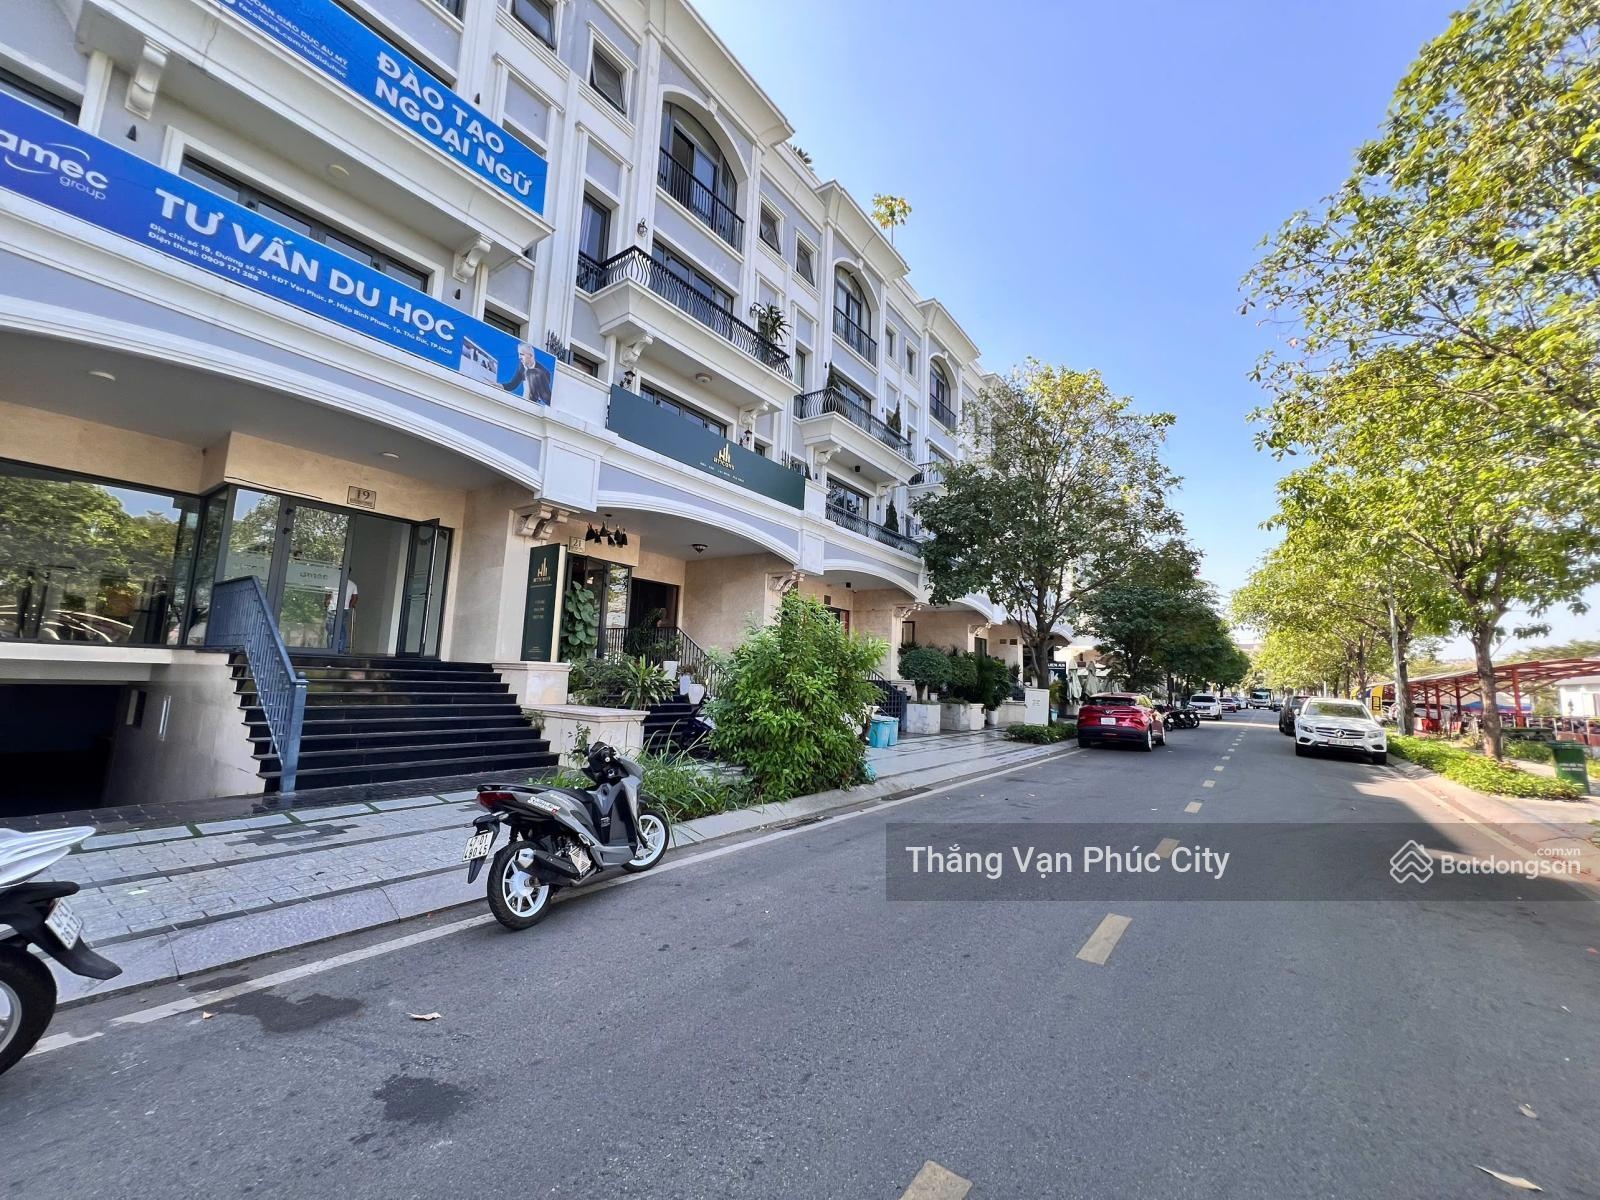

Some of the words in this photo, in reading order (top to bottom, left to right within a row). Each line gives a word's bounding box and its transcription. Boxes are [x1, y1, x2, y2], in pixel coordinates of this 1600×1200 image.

[376, 50, 444, 111] ĐÀO
[452, 103, 504, 153] TẠO
[0, 129, 108, 190] amec
[375, 77, 470, 157] NGOẠI
[476, 148, 533, 196] NGỮ
[59, 176, 106, 200] group
[148, 231, 171, 245] Điện
[172, 241, 199, 257] thoại:
[201, 253, 225, 268] 0909
[155, 187, 225, 236] TƯ
[231, 222, 320, 283] VẤN
[328, 268, 380, 307] DU
[388, 295, 455, 342] HỌC
[200, 244, 213, 255] 19,
[257, 268, 270, 279] 29,
[355, 489, 371, 501] 19
